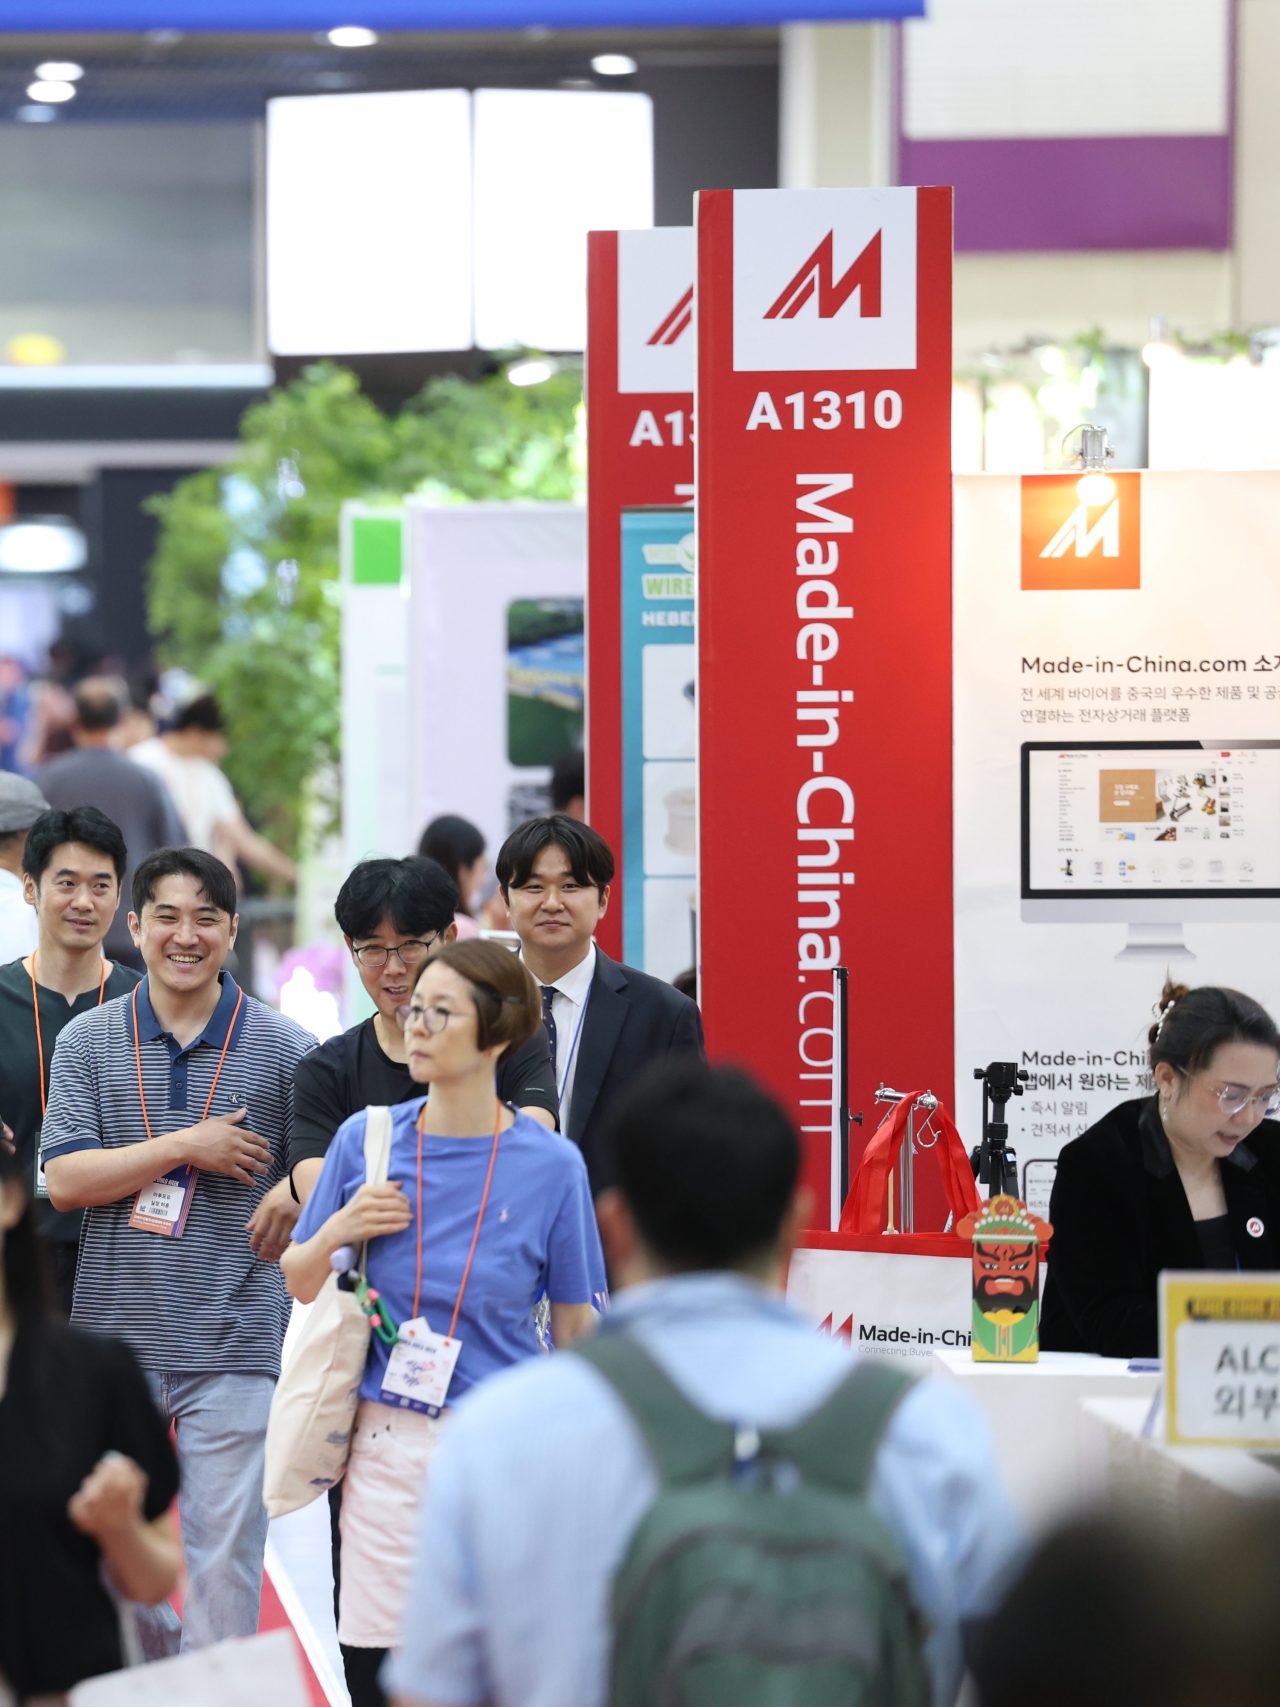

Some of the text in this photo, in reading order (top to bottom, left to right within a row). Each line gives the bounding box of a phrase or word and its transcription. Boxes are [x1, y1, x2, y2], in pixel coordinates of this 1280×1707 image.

[745, 389, 903, 431] A1310
[629, 409, 694, 447] A1
[641, 610, 694, 627] HEBE
[1021, 655, 1247, 674] Made-in-China.com
[1020, 687, 1033, 701] 전
[1037, 687, 1065, 701] 세계
[1068, 687, 1121, 701] 바이어를
[1126, 686, 1167, 701] 중국의
[1171, 686, 1212, 700] 우수한
[1215, 686, 1243, 700] 제품
[1247, 686, 1261, 700] 및
[1020, 708, 1191, 724] 연결하는 전자상거래 플랫폼
[795, 472, 855, 1133] Made-in-China.com
[1024, 1073, 1156, 1091] 앱에서 원하는 제
[1030, 1101, 1088, 1116] 즉시 알림
[1031, 1123, 1070, 1137] 견적서
[859, 1324, 972, 1347] Made-in-Chi
[858, 1345, 907, 1357] Connecting
